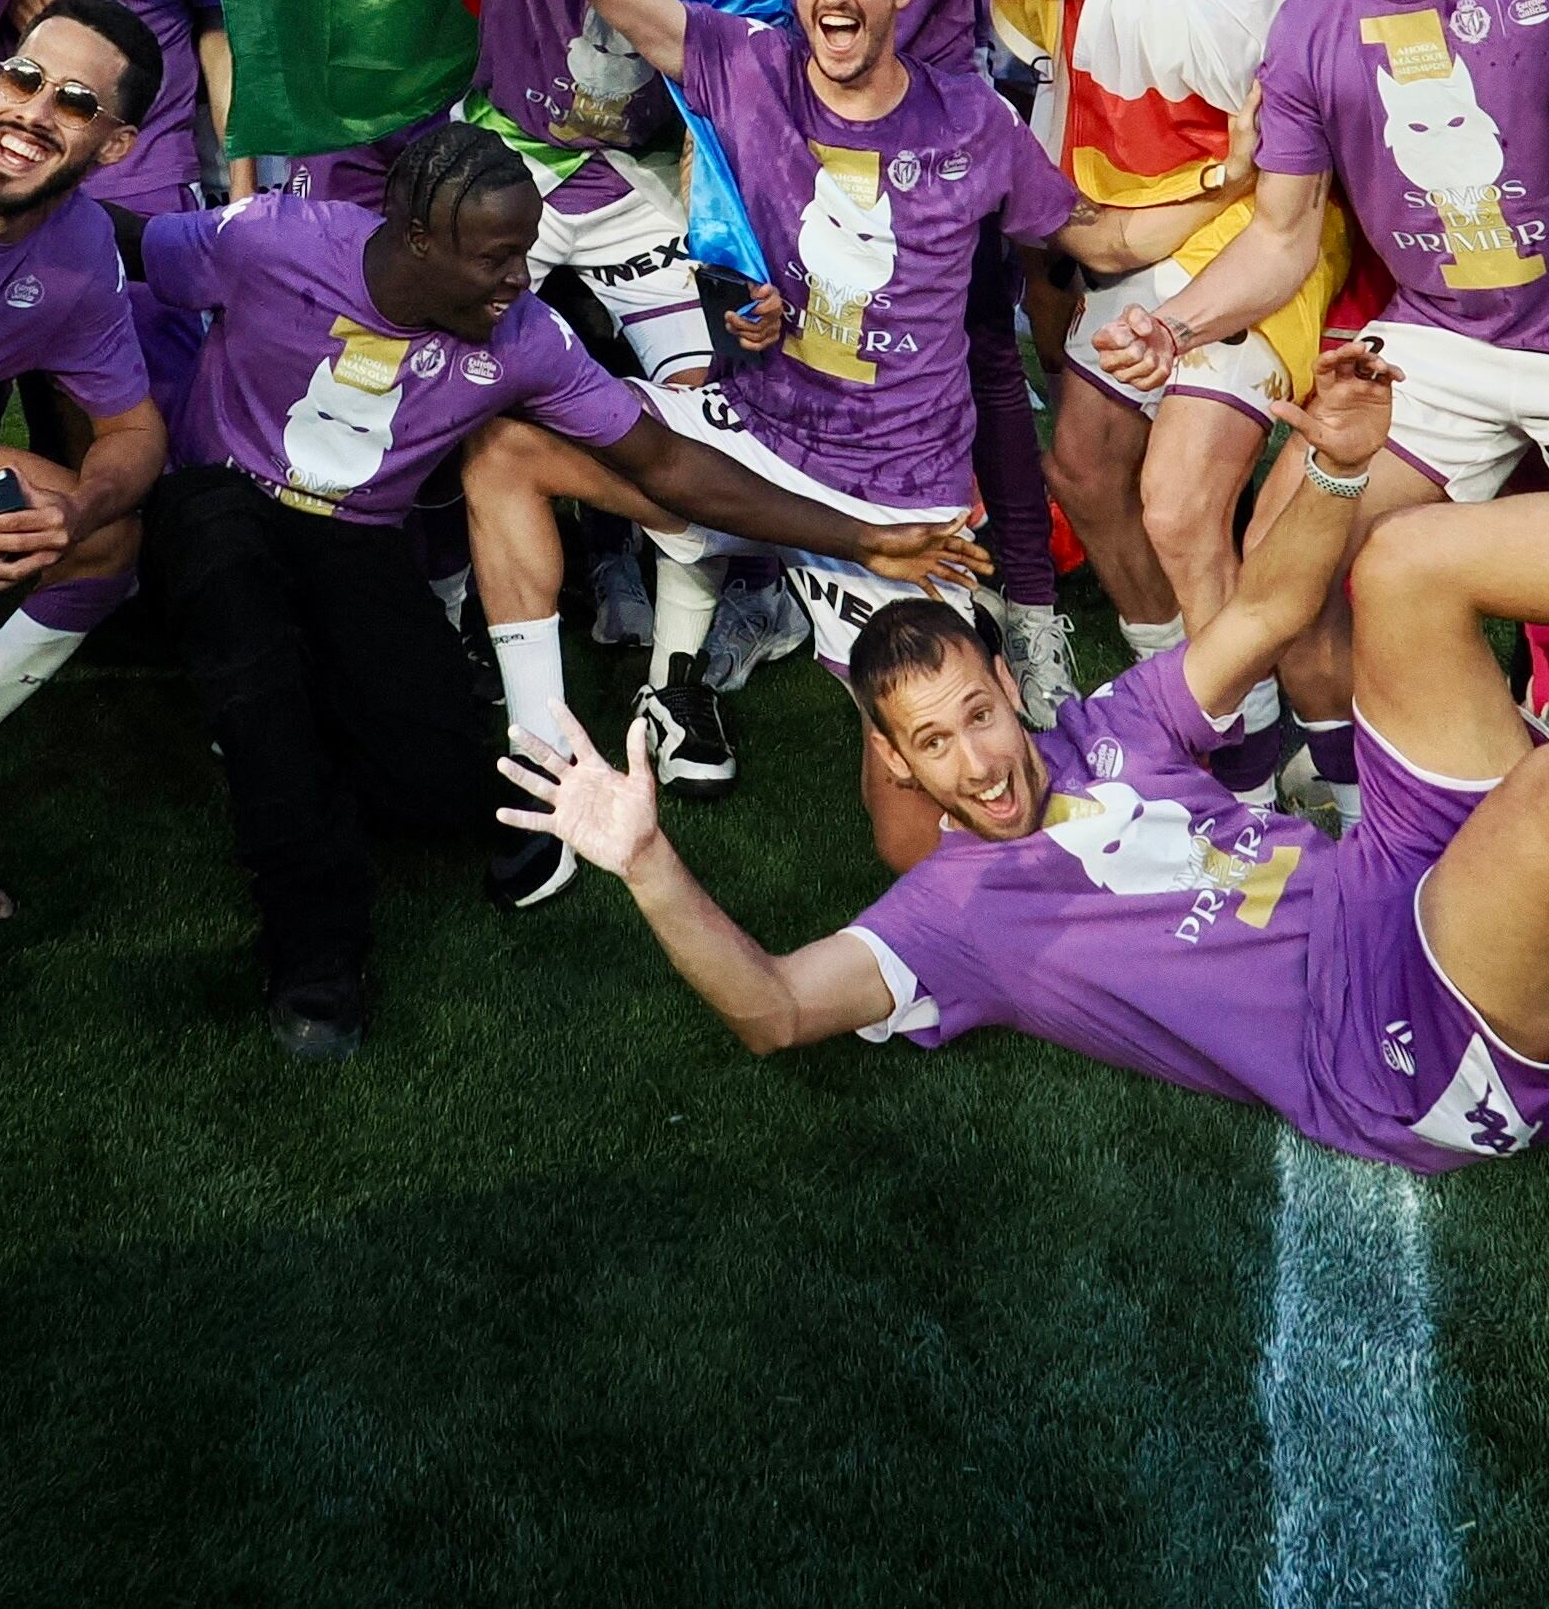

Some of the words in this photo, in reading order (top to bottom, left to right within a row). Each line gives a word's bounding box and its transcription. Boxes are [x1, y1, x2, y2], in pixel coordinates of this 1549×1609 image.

[1403, 179, 1527, 209] SOMOS
[593, 233, 690, 287] INEX
[784, 261, 892, 310] SOMOS
[782, 298, 919, 352] RIMERA
[795, 567, 874, 631] INE
